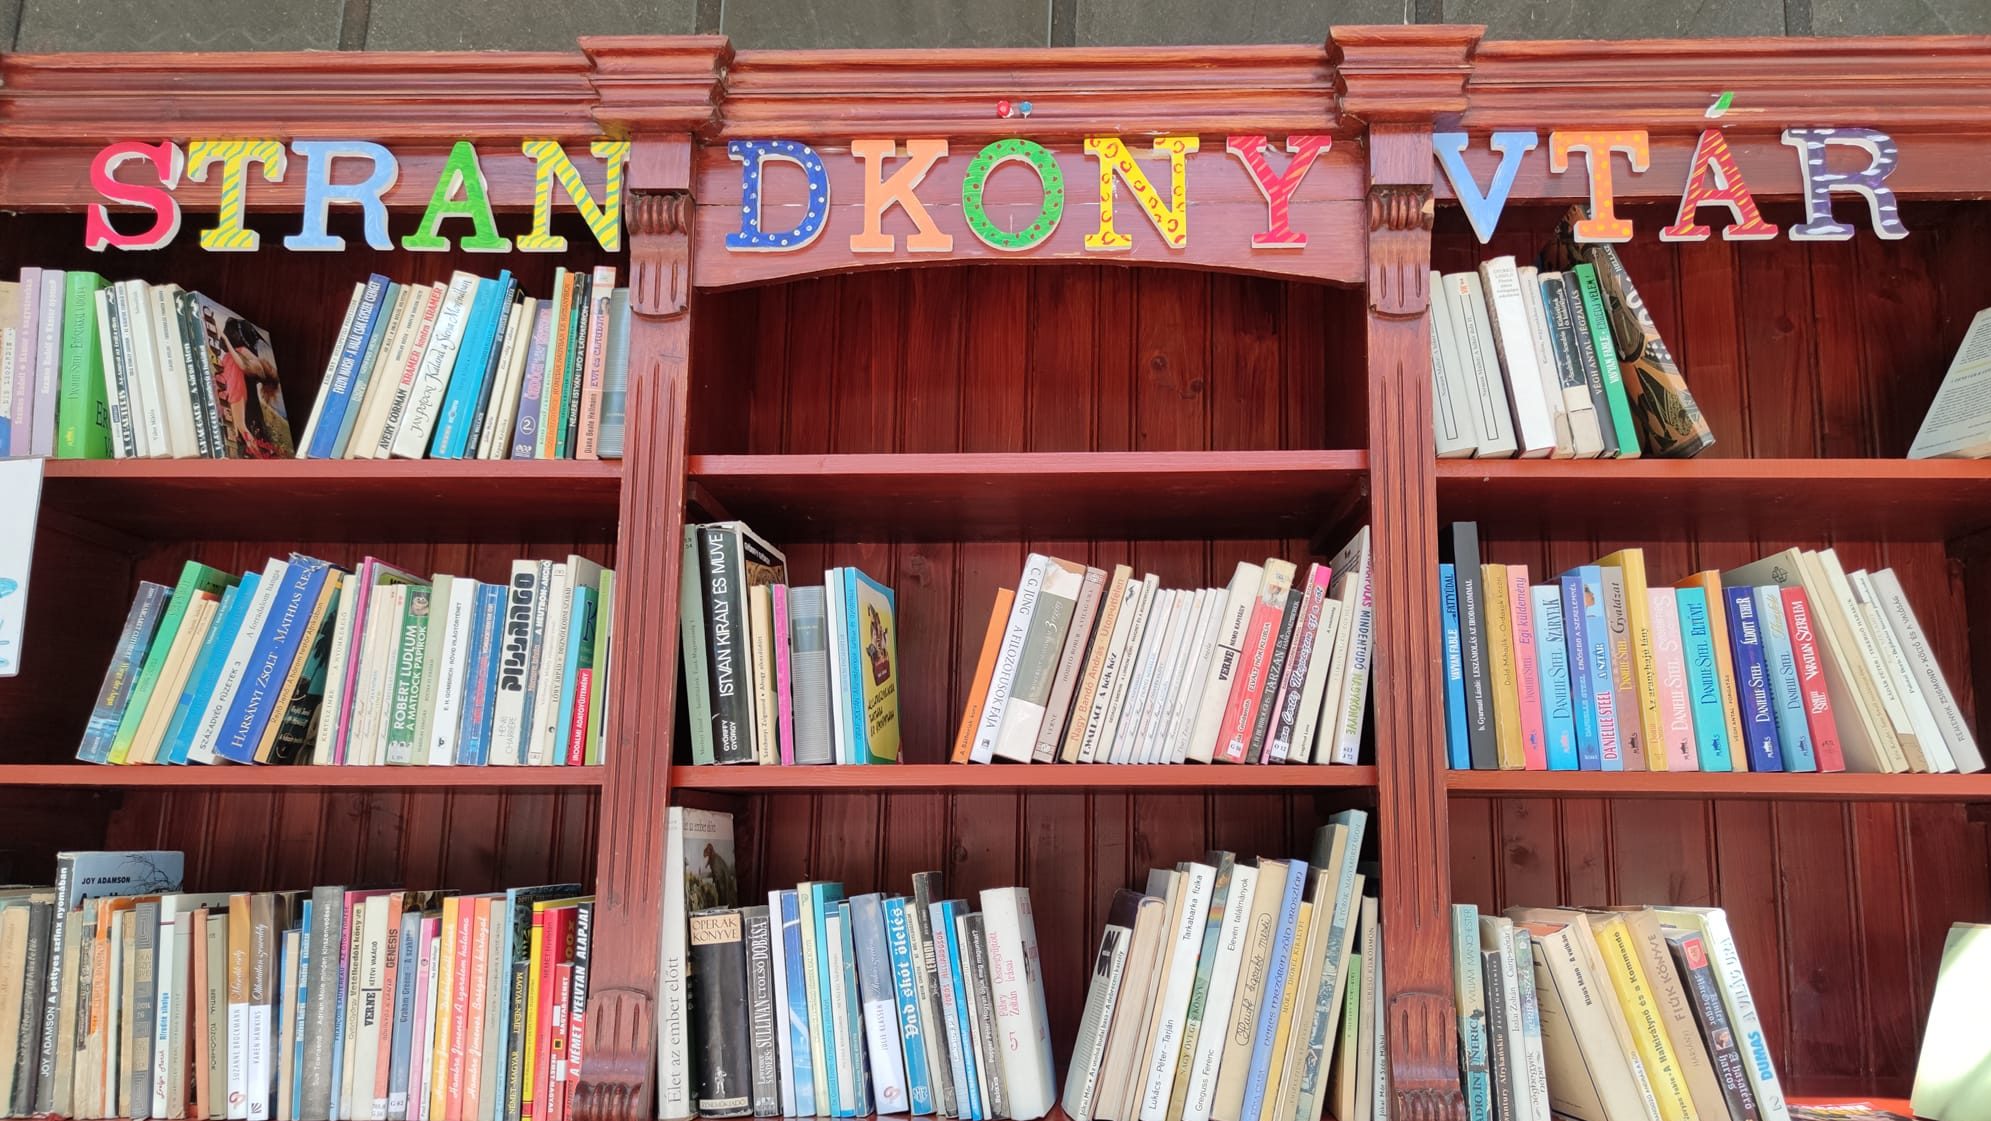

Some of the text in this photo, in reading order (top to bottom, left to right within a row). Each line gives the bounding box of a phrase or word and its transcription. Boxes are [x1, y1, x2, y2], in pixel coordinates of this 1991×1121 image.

[575, 357, 584, 371] UFO
[1572, 289, 1603, 395] VÉGH ANTAL JÉGZAJLÁS
[380, 424, 395, 450] AVERY
[388, 389, 407, 423] CORMAN
[401, 350, 420, 385] KRAMER
[414, 324, 430, 348] kontra
[424, 287, 442, 322] KRAMER
[585, 420, 595, 436] Beate
[586, 394, 597, 419] Hellmann
[584, 438, 593, 454] Diana
[1514, 576, 1530, 626] küldemény
[1610, 582, 1625, 634] Gyalázat
[413, 624, 426, 669] PAPÍROK
[985, 567, 1041, 730] C. G. JUNG A FÁJA
[1448, 629, 1458, 653] FABLE
[1542, 598, 1570, 720] DANIELLE STEEL SZÁRNYAK
[1736, 596, 1770, 722] DANIELLE STEEL ÁLDOTT TEHER
[232, 592, 302, 748] HARSÁNYI ZSOLT MATHIAS
[393, 624, 417, 730] ROBERT LUDLUM
[1218, 650, 1234, 681] VERNE
[1264, 651, 1284, 694] TARZAN
[1449, 654, 1460, 681] VAVYAN
[1619, 662, 1633, 691] DANIELLE
[1695, 640, 1718, 705] DANIELLE STEEL
[1779, 651, 1801, 710] DANIELLE STEEL
[408, 672, 421, 720] MATLOCK
[1664, 659, 1688, 731] DANIELLE STEEL
[406, 723, 415, 731] A
[572, 729, 583, 761] IRODALMI
[1070, 715, 1086, 742] Nagy
[1596, 691, 1618, 760] DANIELLE STEEL
[82, 875, 131, 884] JOY ADAMSON
[1182, 875, 1204, 941] Tarkabarka fizika
[1226, 878, 1249, 952] Eleven találmányok
[40, 867, 68, 1077] JOY ADAMSON A pettyes szfinx nyomában
[320, 956, 329, 981] minden
[385, 928, 398, 968] GENESIS
[923, 940, 937, 973] LENNON
[1561, 934, 1593, 1006] Klaus Mann vulkán
[318, 983, 327, 1000] Mole
[571, 908, 589, 1077] A NÉMET NYELVTAN ALAPJAI
[750, 921, 772, 1048] SULLIVAN DOBÁSA
[1638, 994, 1646, 1007] és
[1647, 934, 1686, 1021] FIÚK KÖNYVE
[316, 1001, 325, 1025] Adrian
[364, 992, 376, 1027] VERNE
[400, 996, 409, 1023] Graham
[998, 993, 1010, 1017] Fábry
[1008, 990, 1021, 1017] Zoltán
[665, 957, 682, 1103] Élet az ember előtt
[1147, 1019, 1175, 1110] Lukács Tarján
[1748, 1031, 1773, 1081] DUMAS
[1195, 1049, 1215, 1112] Greguss Ferenc
